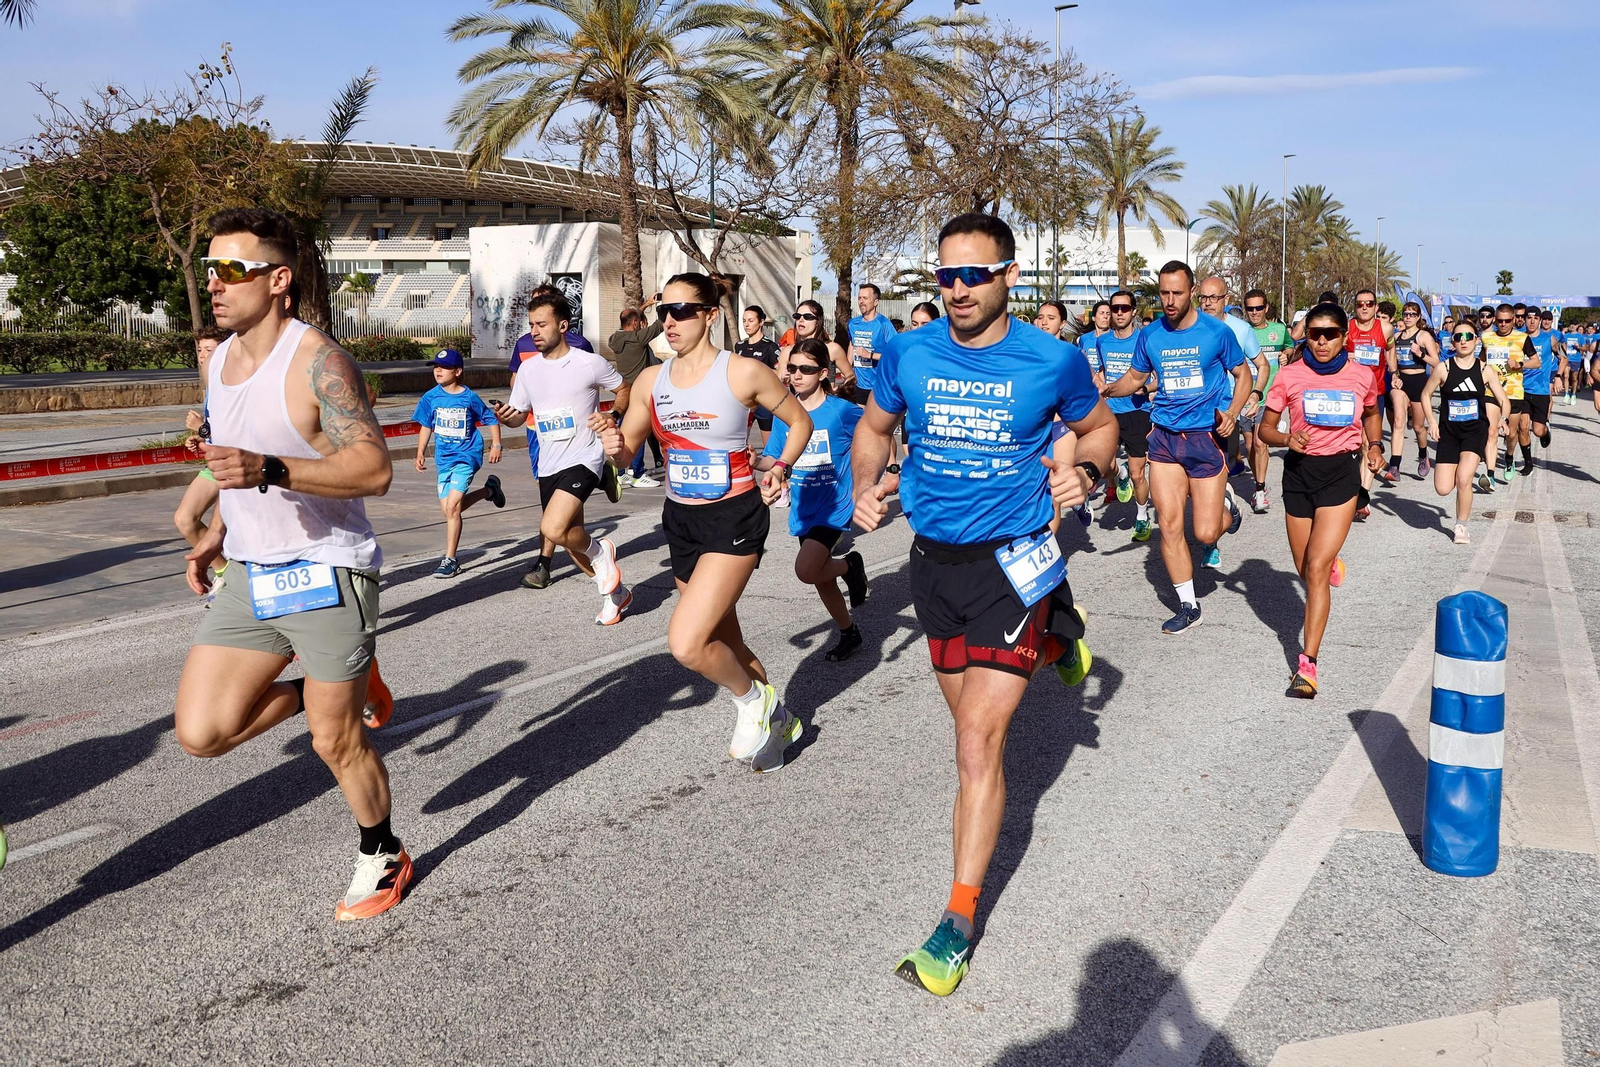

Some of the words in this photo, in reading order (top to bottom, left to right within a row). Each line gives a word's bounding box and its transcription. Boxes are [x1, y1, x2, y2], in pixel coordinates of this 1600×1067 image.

[1161, 346, 1199, 358] mayoral
[927, 378, 1012, 398] mayoral
[1173, 377, 1191, 388] 187
[924, 402, 1009, 421] RUNNING
[1317, 401, 1341, 412] 508
[1456, 406, 1470, 414] 997
[440, 420, 459, 428] 1189
[543, 418, 567, 430] 1791
[933, 415, 1001, 431] MAKES
[927, 425, 997, 441] FRIENDS
[805, 441, 820, 453] 37
[681, 465, 710, 480] 945
[1027, 543, 1054, 571] 143
[274, 568, 312, 591] 603
[1019, 580, 1038, 594] 10KM
[254, 598, 274, 608] 10KM
